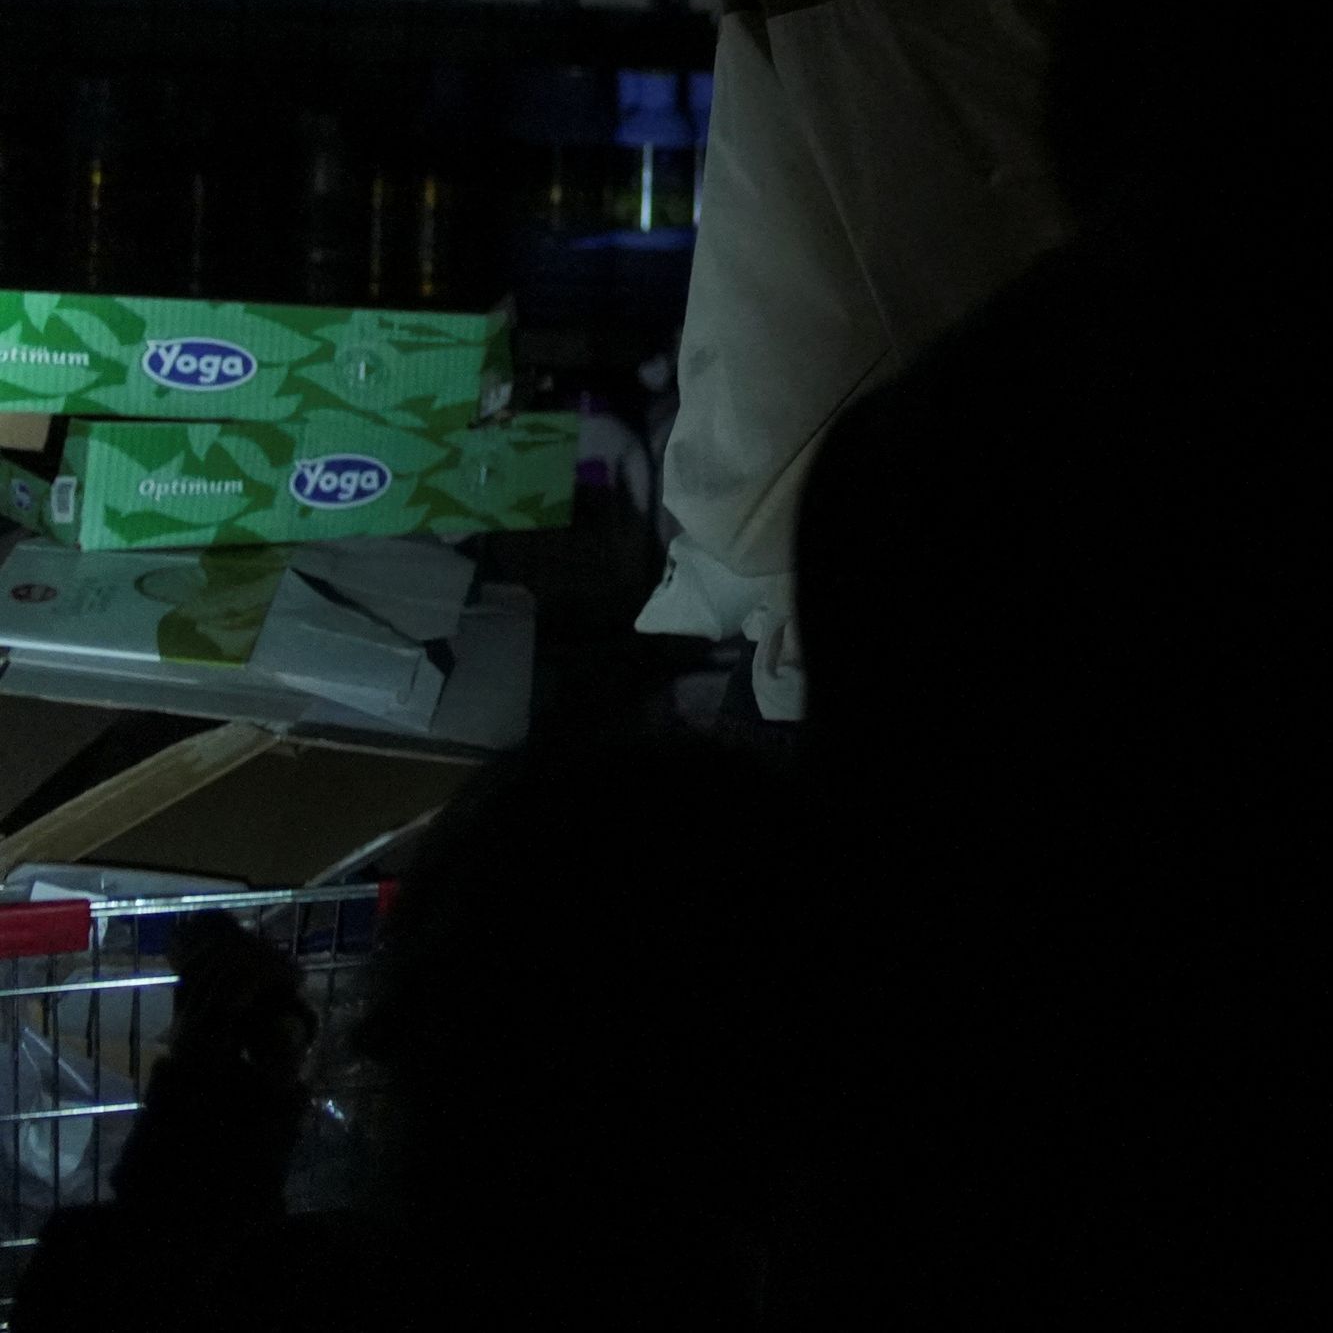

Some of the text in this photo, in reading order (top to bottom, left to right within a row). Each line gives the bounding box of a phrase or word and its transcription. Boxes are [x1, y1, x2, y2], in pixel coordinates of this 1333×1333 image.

[146, 339, 244, 382] Yoga
[138, 459, 380, 501] Optimum Yoga
